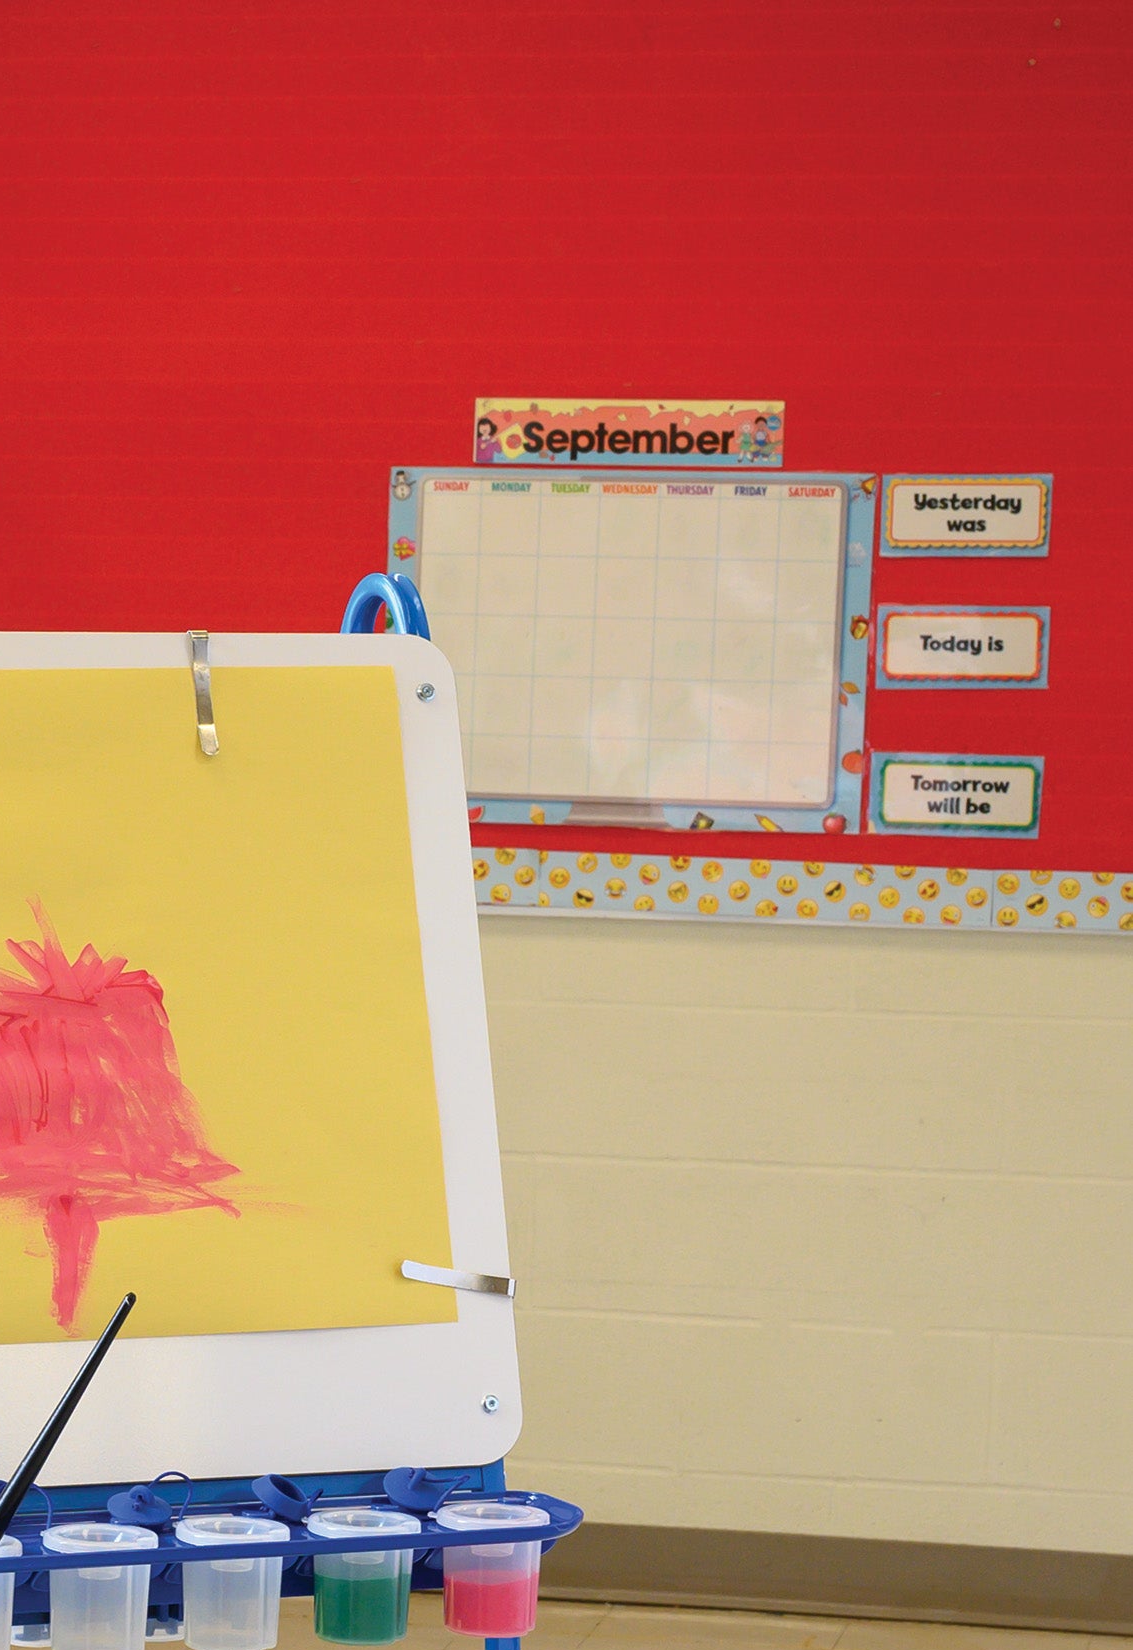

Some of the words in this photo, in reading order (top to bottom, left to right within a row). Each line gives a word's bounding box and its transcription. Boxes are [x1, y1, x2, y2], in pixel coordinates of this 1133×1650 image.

[523, 421, 735, 461] September
[433, 481, 470, 492] SUNDAY
[491, 482, 532, 493] MONDAY
[551, 483, 591, 494] TUESDAY
[602, 483, 658, 495] WEDNESDAY
[667, 485, 714, 496] THURSDAY
[734, 486, 767, 497] FRIDAY
[788, 487, 836, 498] SATURDAY
[914, 493, 1022, 515] Yesterday
[947, 519, 986, 532] was
[920, 635, 982, 656] Today
[987, 636, 1004, 652] is
[911, 774, 1010, 793] Tomorrow
[927, 797, 960, 814] will
[965, 798, 991, 814] be
